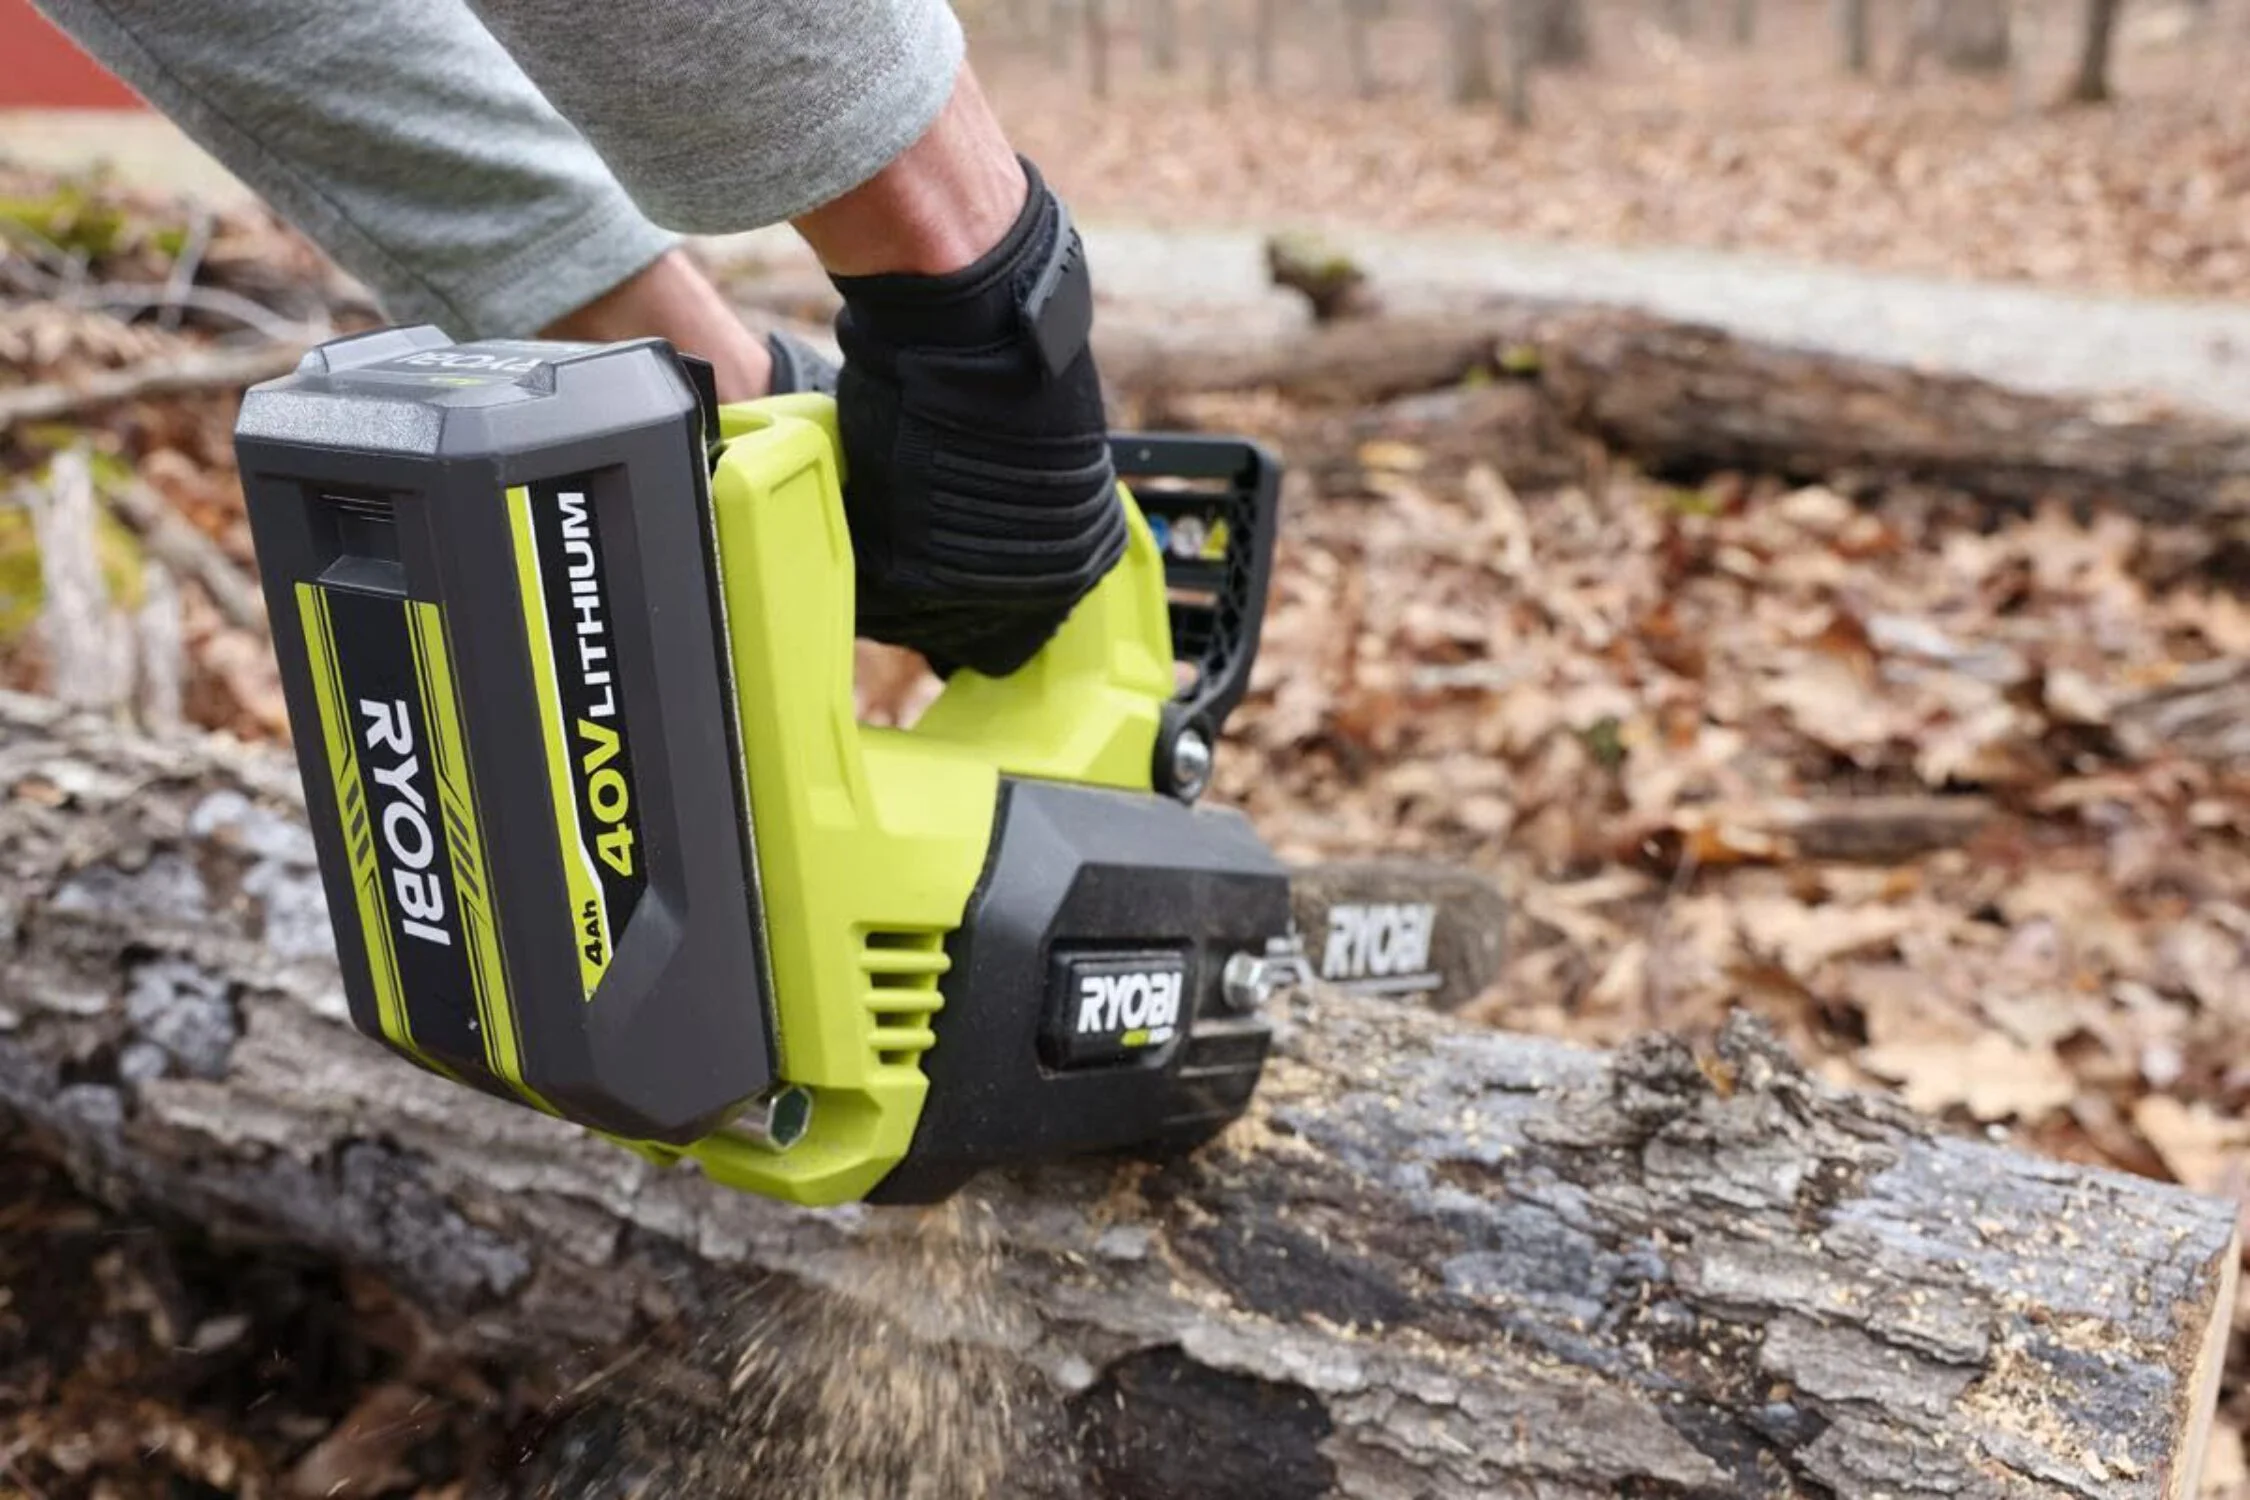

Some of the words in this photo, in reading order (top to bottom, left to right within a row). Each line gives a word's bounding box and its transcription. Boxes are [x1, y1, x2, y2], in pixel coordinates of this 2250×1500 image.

[557, 492, 616, 718] LITHIUM
[359, 698, 452, 946] RYOBI
[577, 717, 635, 877] 40V
[584, 900, 603, 967] 4Ah
[1322, 902, 1437, 979] RYOBI
[1077, 971, 1183, 1034] RYOBI
